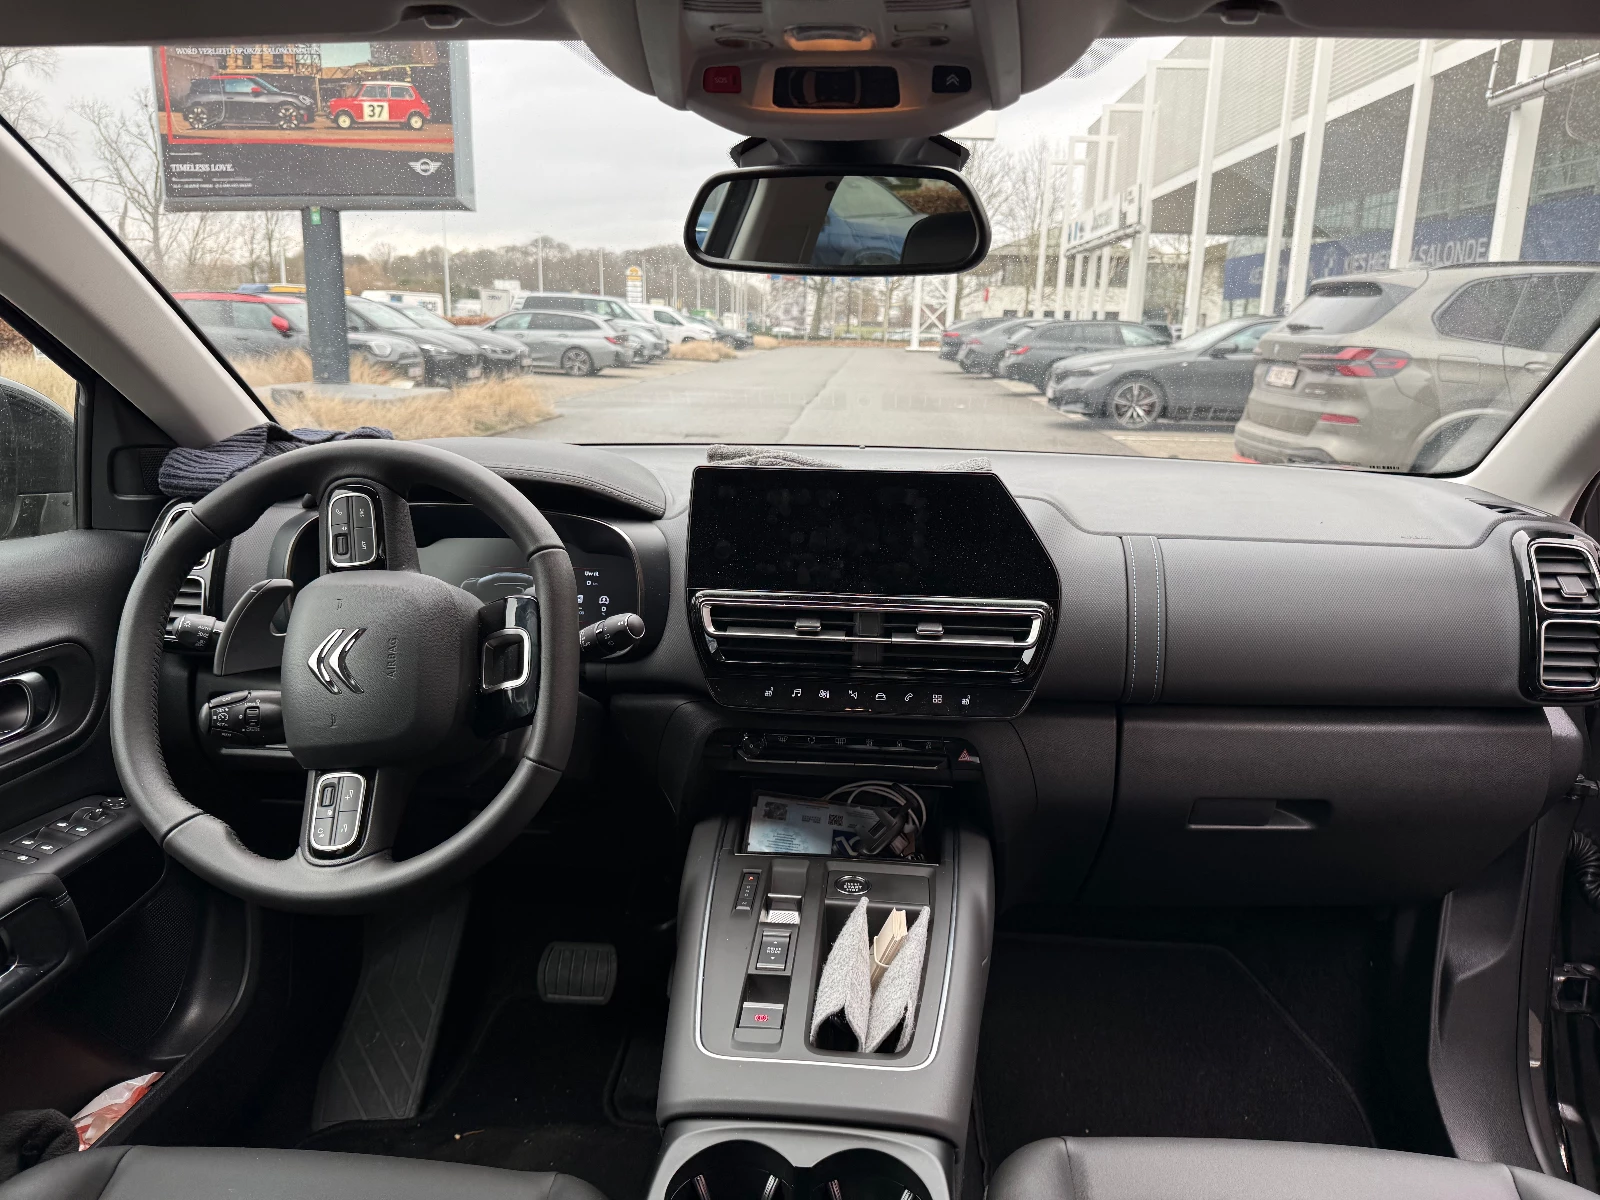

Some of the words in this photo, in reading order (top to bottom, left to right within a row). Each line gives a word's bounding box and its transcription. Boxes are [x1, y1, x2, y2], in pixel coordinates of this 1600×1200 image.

[175, 47, 198, 55] WORD
[198, 47, 233, 55] VERLIEFD
[233, 47, 244, 55] OP
[713, 76, 728, 84] SOS
[368, 104, 385, 118] 37
[170, 163, 210, 172] TIMELESS
[386, 637, 397, 679] AIRBAG
